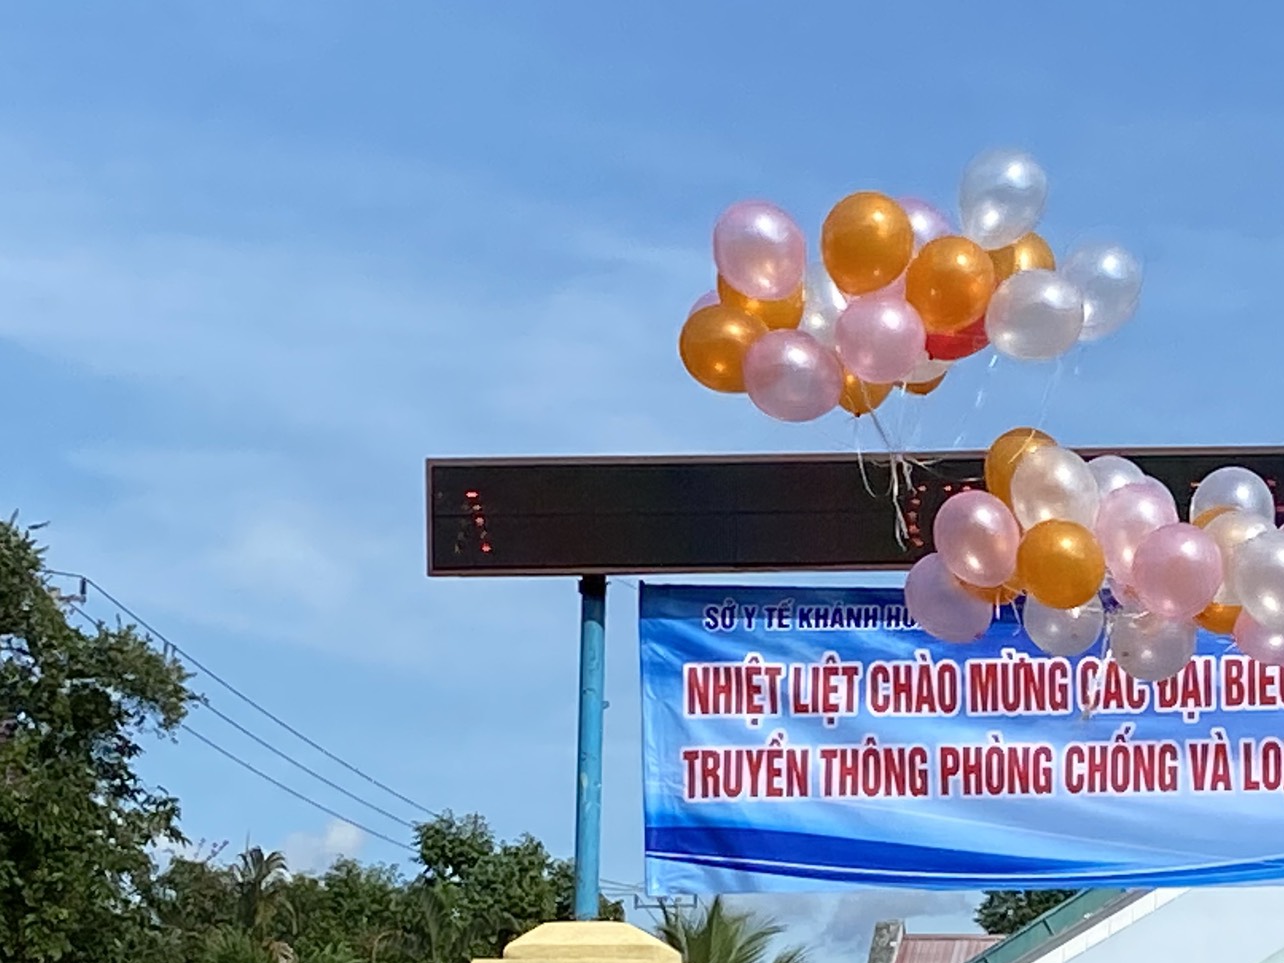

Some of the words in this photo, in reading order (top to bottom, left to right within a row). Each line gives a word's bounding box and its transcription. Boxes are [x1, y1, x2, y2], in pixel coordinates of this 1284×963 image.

[705, 599, 736, 629] SỞ
[744, 607, 756, 628] Y
[765, 600, 792, 628] TẾ
[798, 603, 878, 628] KHÁNH
[688, 656, 781, 726] NHIỆT
[793, 655, 859, 725] LIỆT
[870, 653, 958, 713] CHÀO
[971, 652, 1070, 713] MỪNG
[683, 733, 809, 798] TRUYỀN
[820, 736, 928, 797] THÔNG
[940, 734, 1053, 796] PHÒNG
[1064, 726, 1178, 793] CHỐNG
[1189, 731, 1232, 791] VÀ
